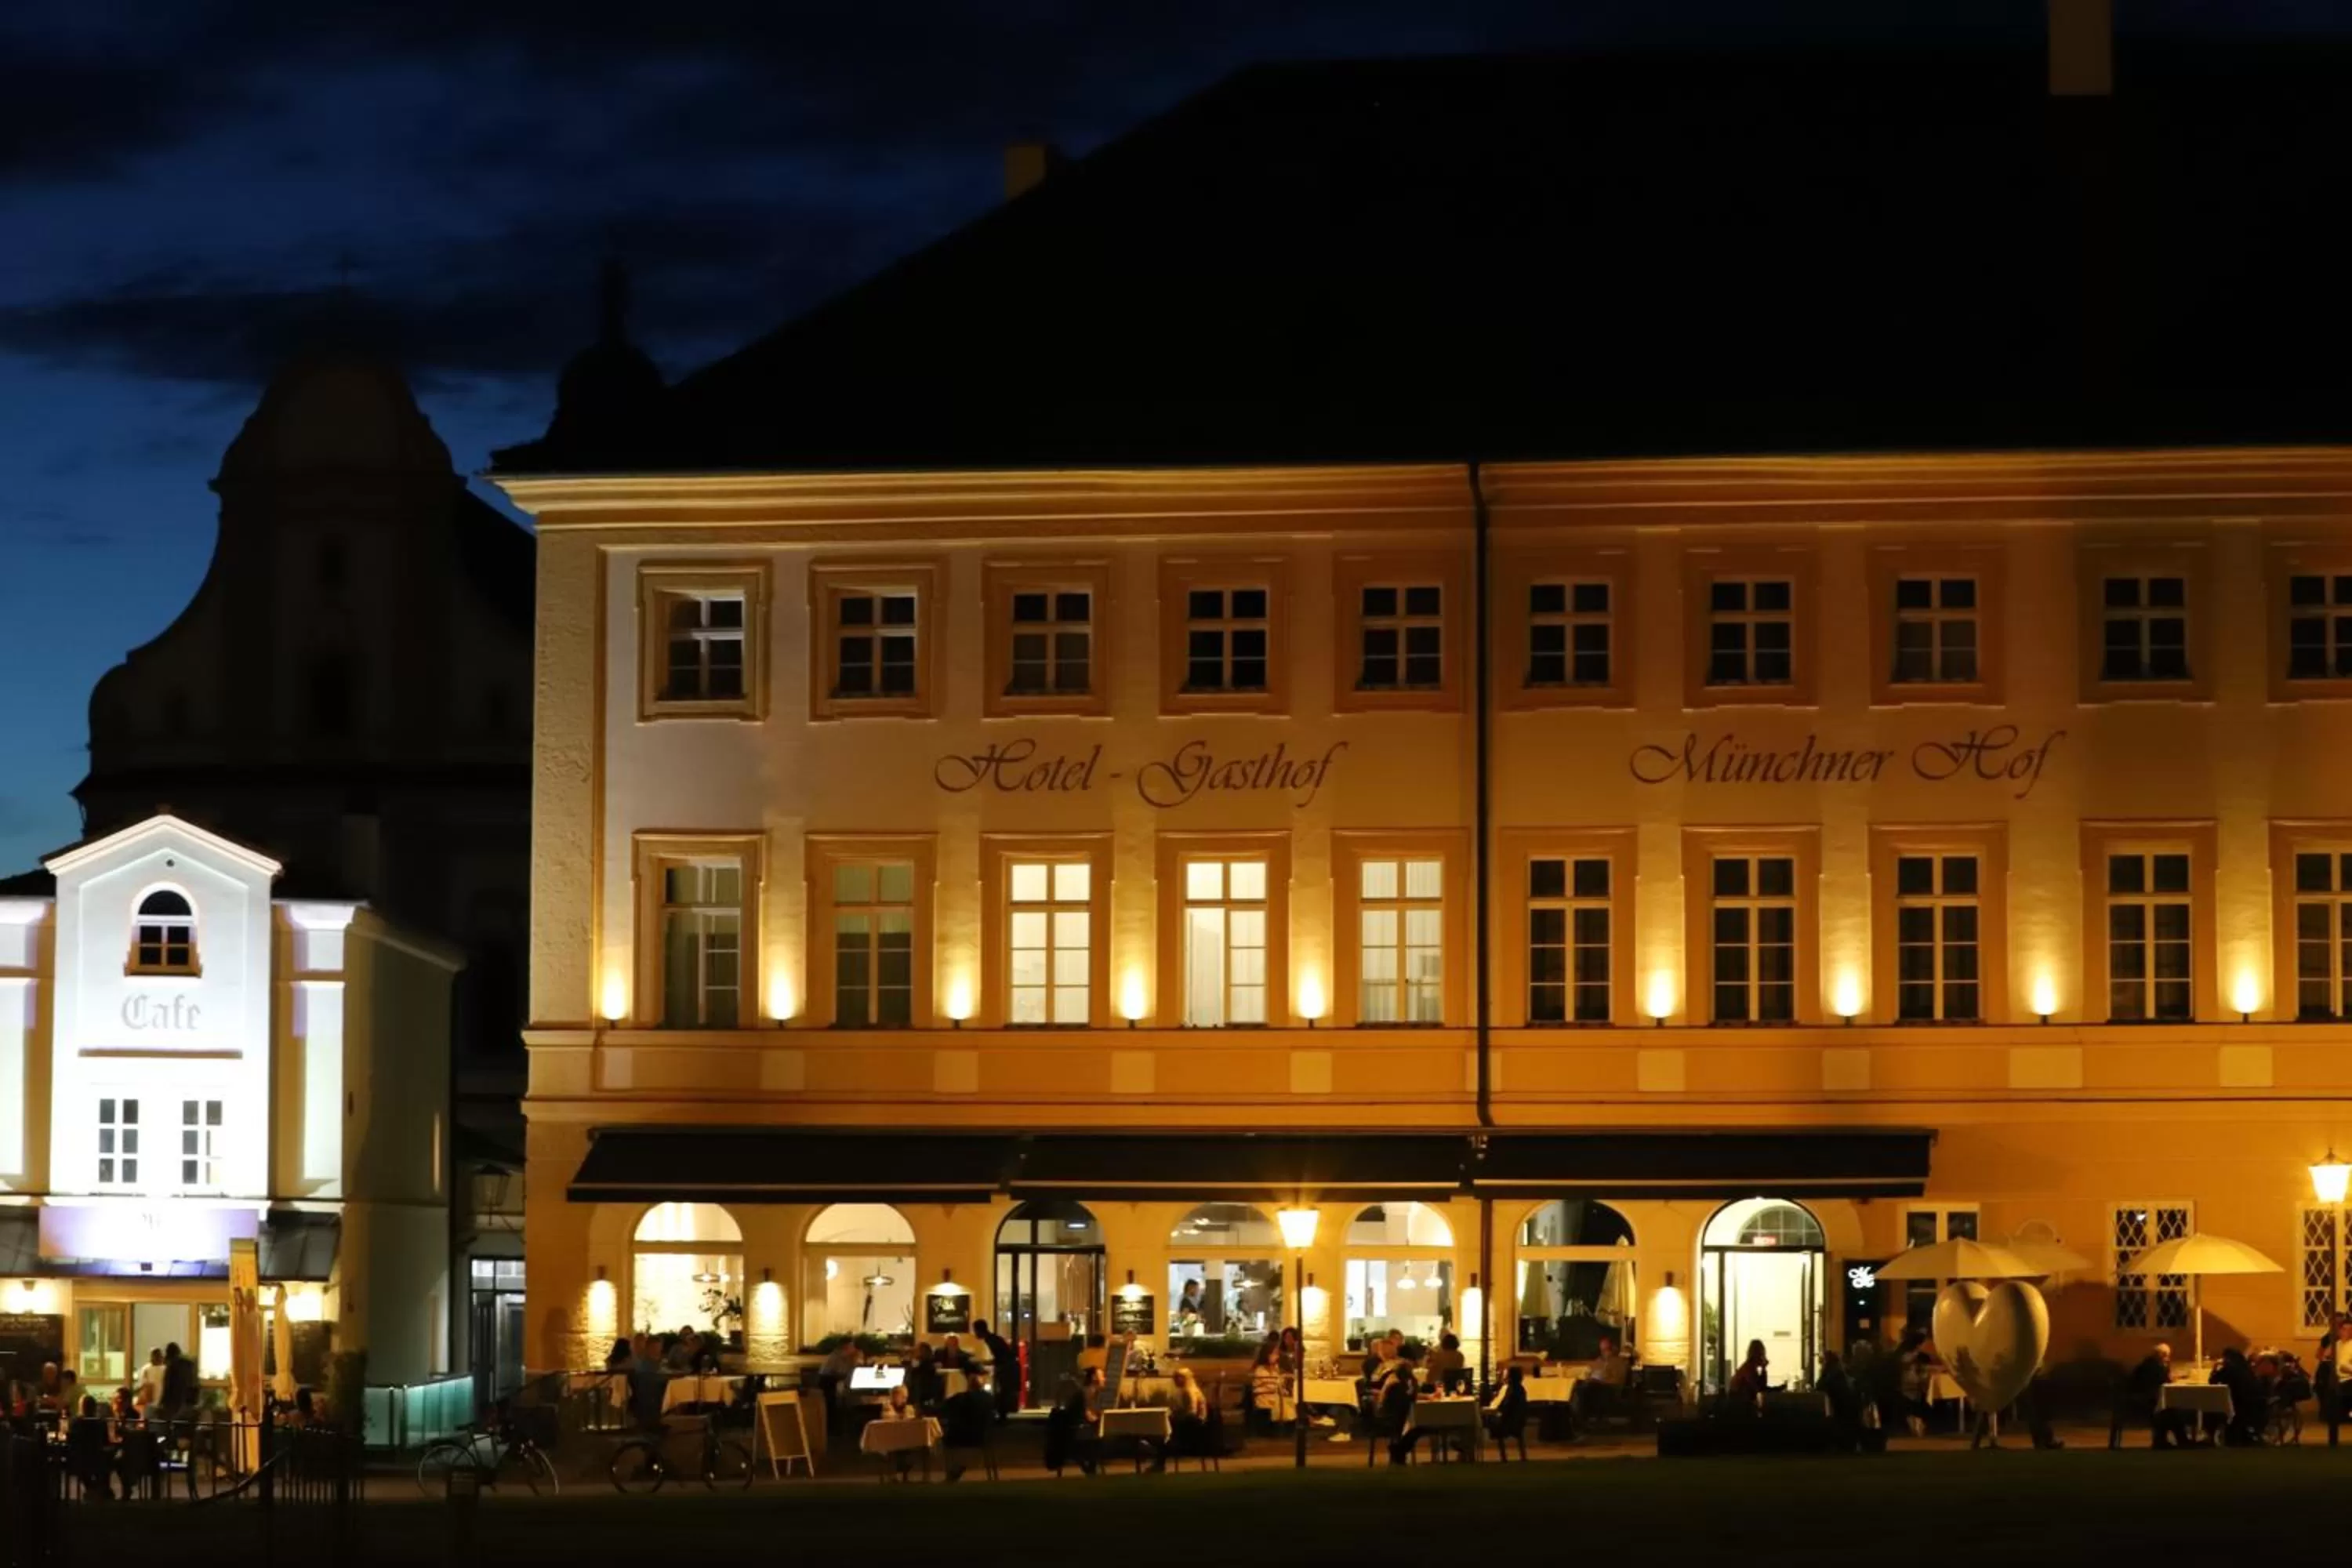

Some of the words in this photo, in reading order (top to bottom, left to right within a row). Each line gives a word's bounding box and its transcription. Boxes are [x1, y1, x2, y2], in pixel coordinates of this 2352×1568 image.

[935, 739, 1102, 792] Hotel
[1137, 740, 1348, 808] Gasthof
[1630, 732, 1894, 783] Münchner
[1911, 724, 2067, 800] Hof
[121, 993, 201, 1030] Cafe
